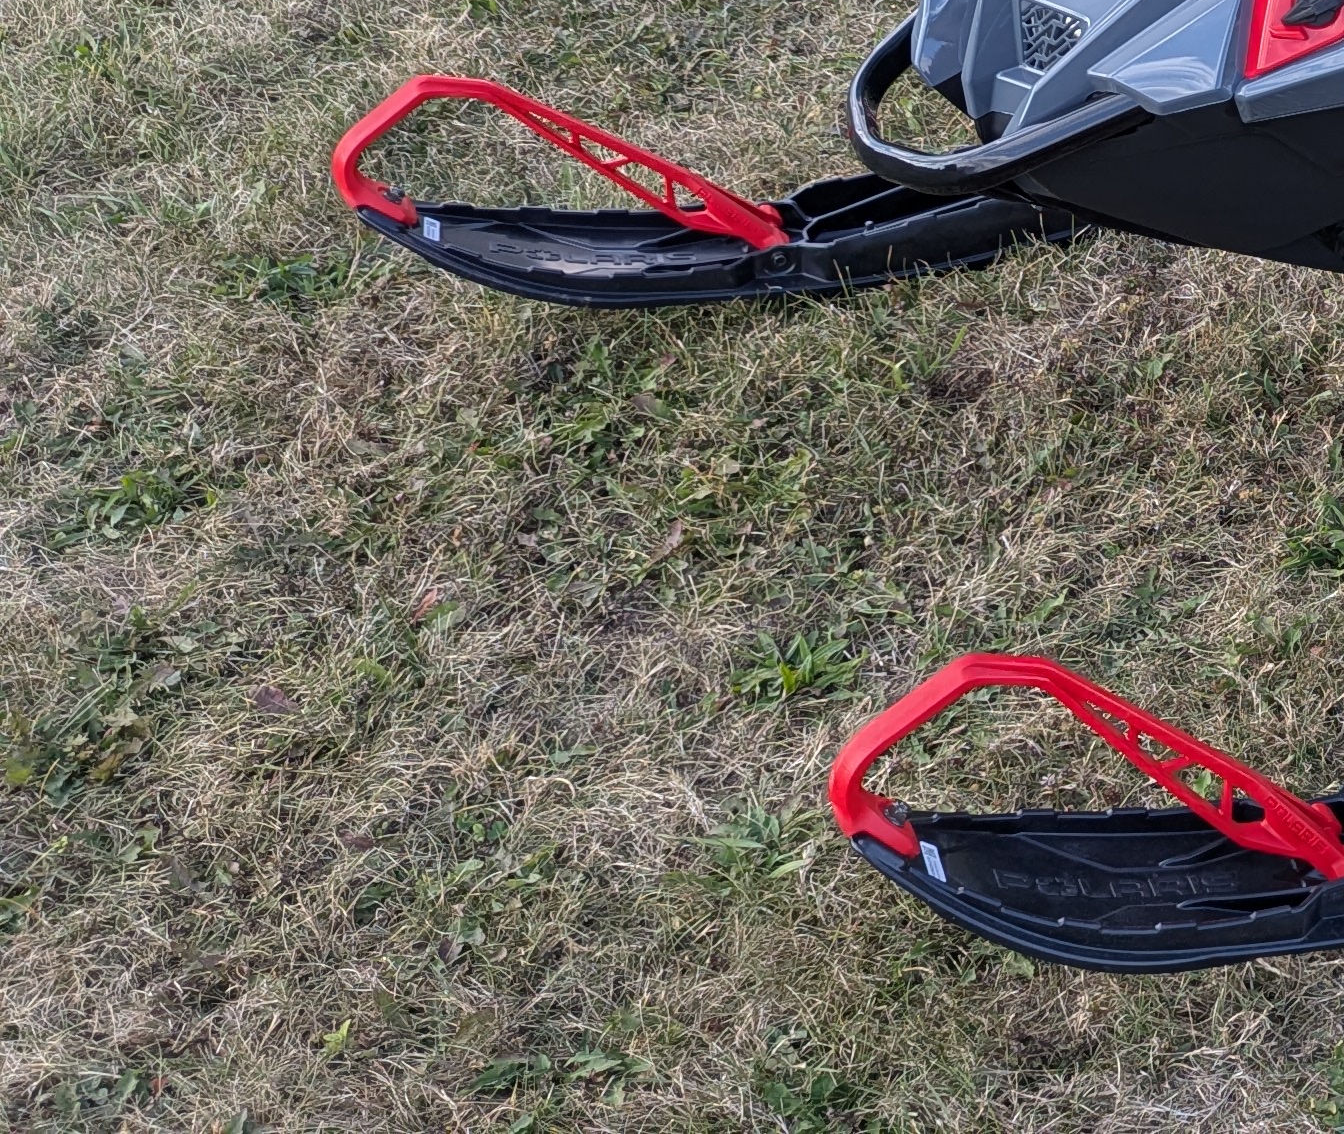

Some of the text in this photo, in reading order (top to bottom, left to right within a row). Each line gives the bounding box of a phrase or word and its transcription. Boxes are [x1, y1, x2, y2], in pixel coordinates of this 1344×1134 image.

[489, 241, 697, 266] POLARIS
[1264, 794, 1330, 855] POLARIS
[992, 868, 1239, 898] POLARIS
